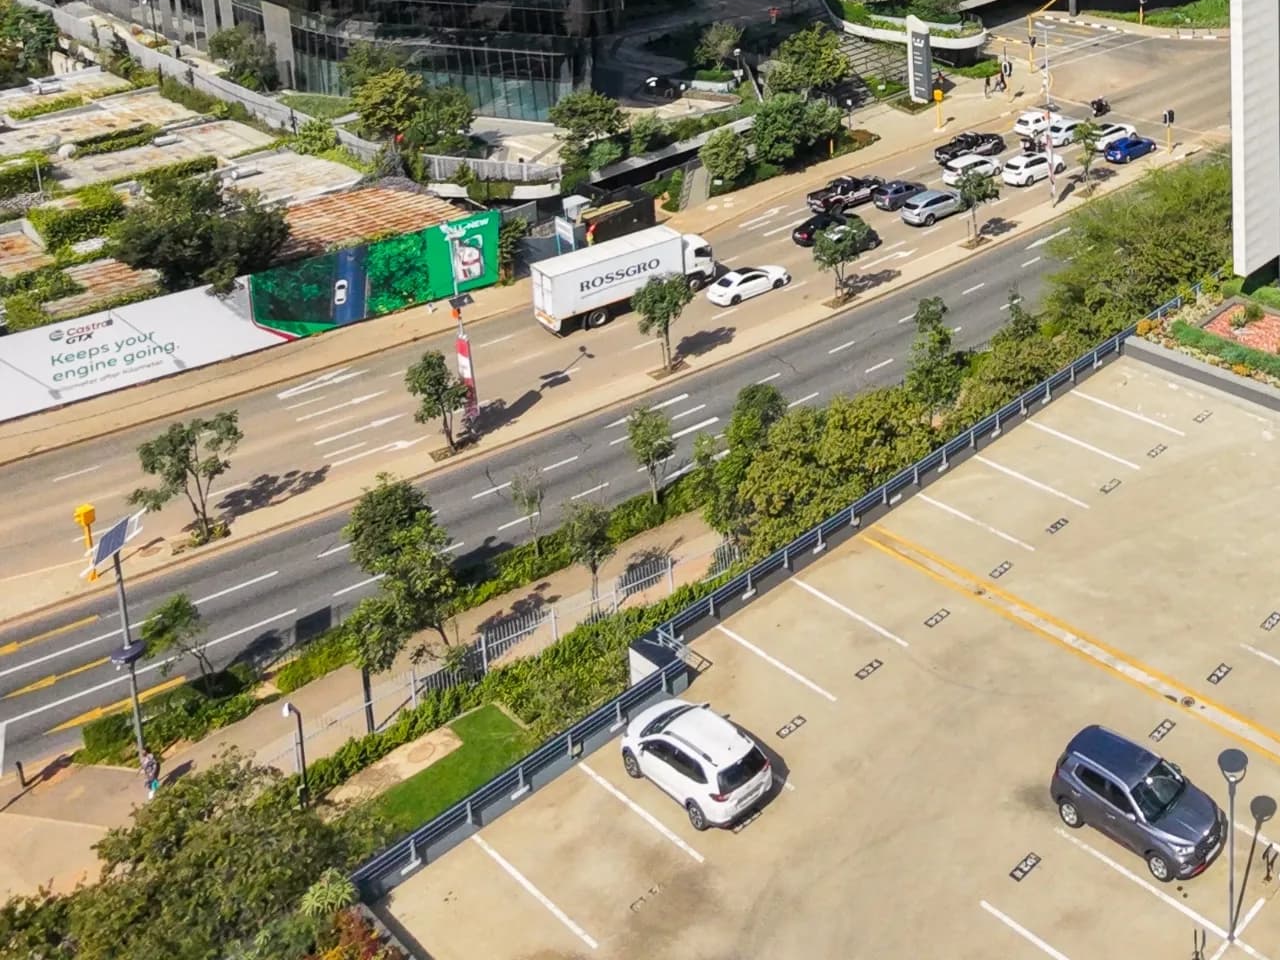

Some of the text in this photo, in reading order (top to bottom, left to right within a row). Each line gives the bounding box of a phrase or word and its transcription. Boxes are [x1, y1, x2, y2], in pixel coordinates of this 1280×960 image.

[579, 258, 661, 292] ROSSGRO
[65, 332, 95, 345] GTX
[66, 319, 112, 337] Castro
[50, 331, 155, 366] Keeps your
[52, 341, 180, 382] engine going.
